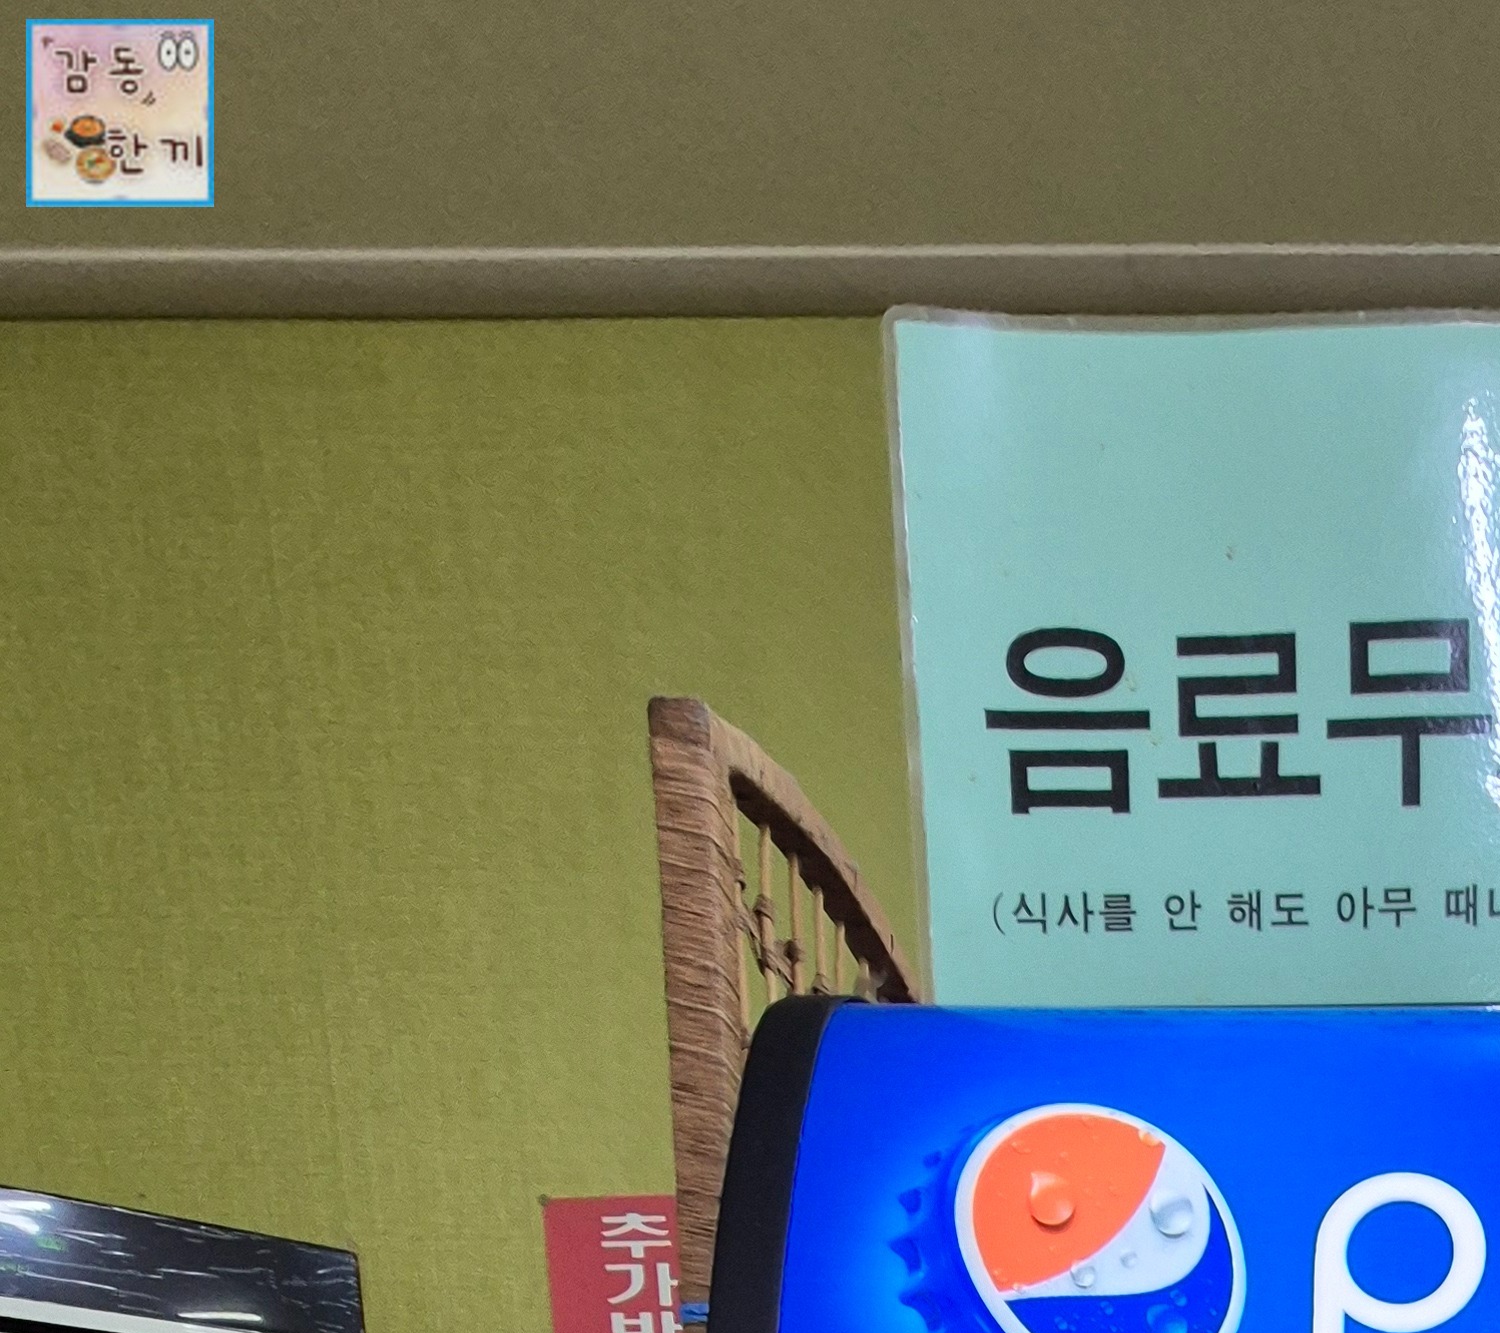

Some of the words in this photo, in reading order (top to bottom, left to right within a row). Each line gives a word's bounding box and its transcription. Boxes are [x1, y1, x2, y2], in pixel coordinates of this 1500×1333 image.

[992, 890, 1138, 936] (식사를
[1163, 893, 1202, 932] 안
[1229, 891, 1312, 932] 해도
[1335, 889, 1416, 932] 아무
